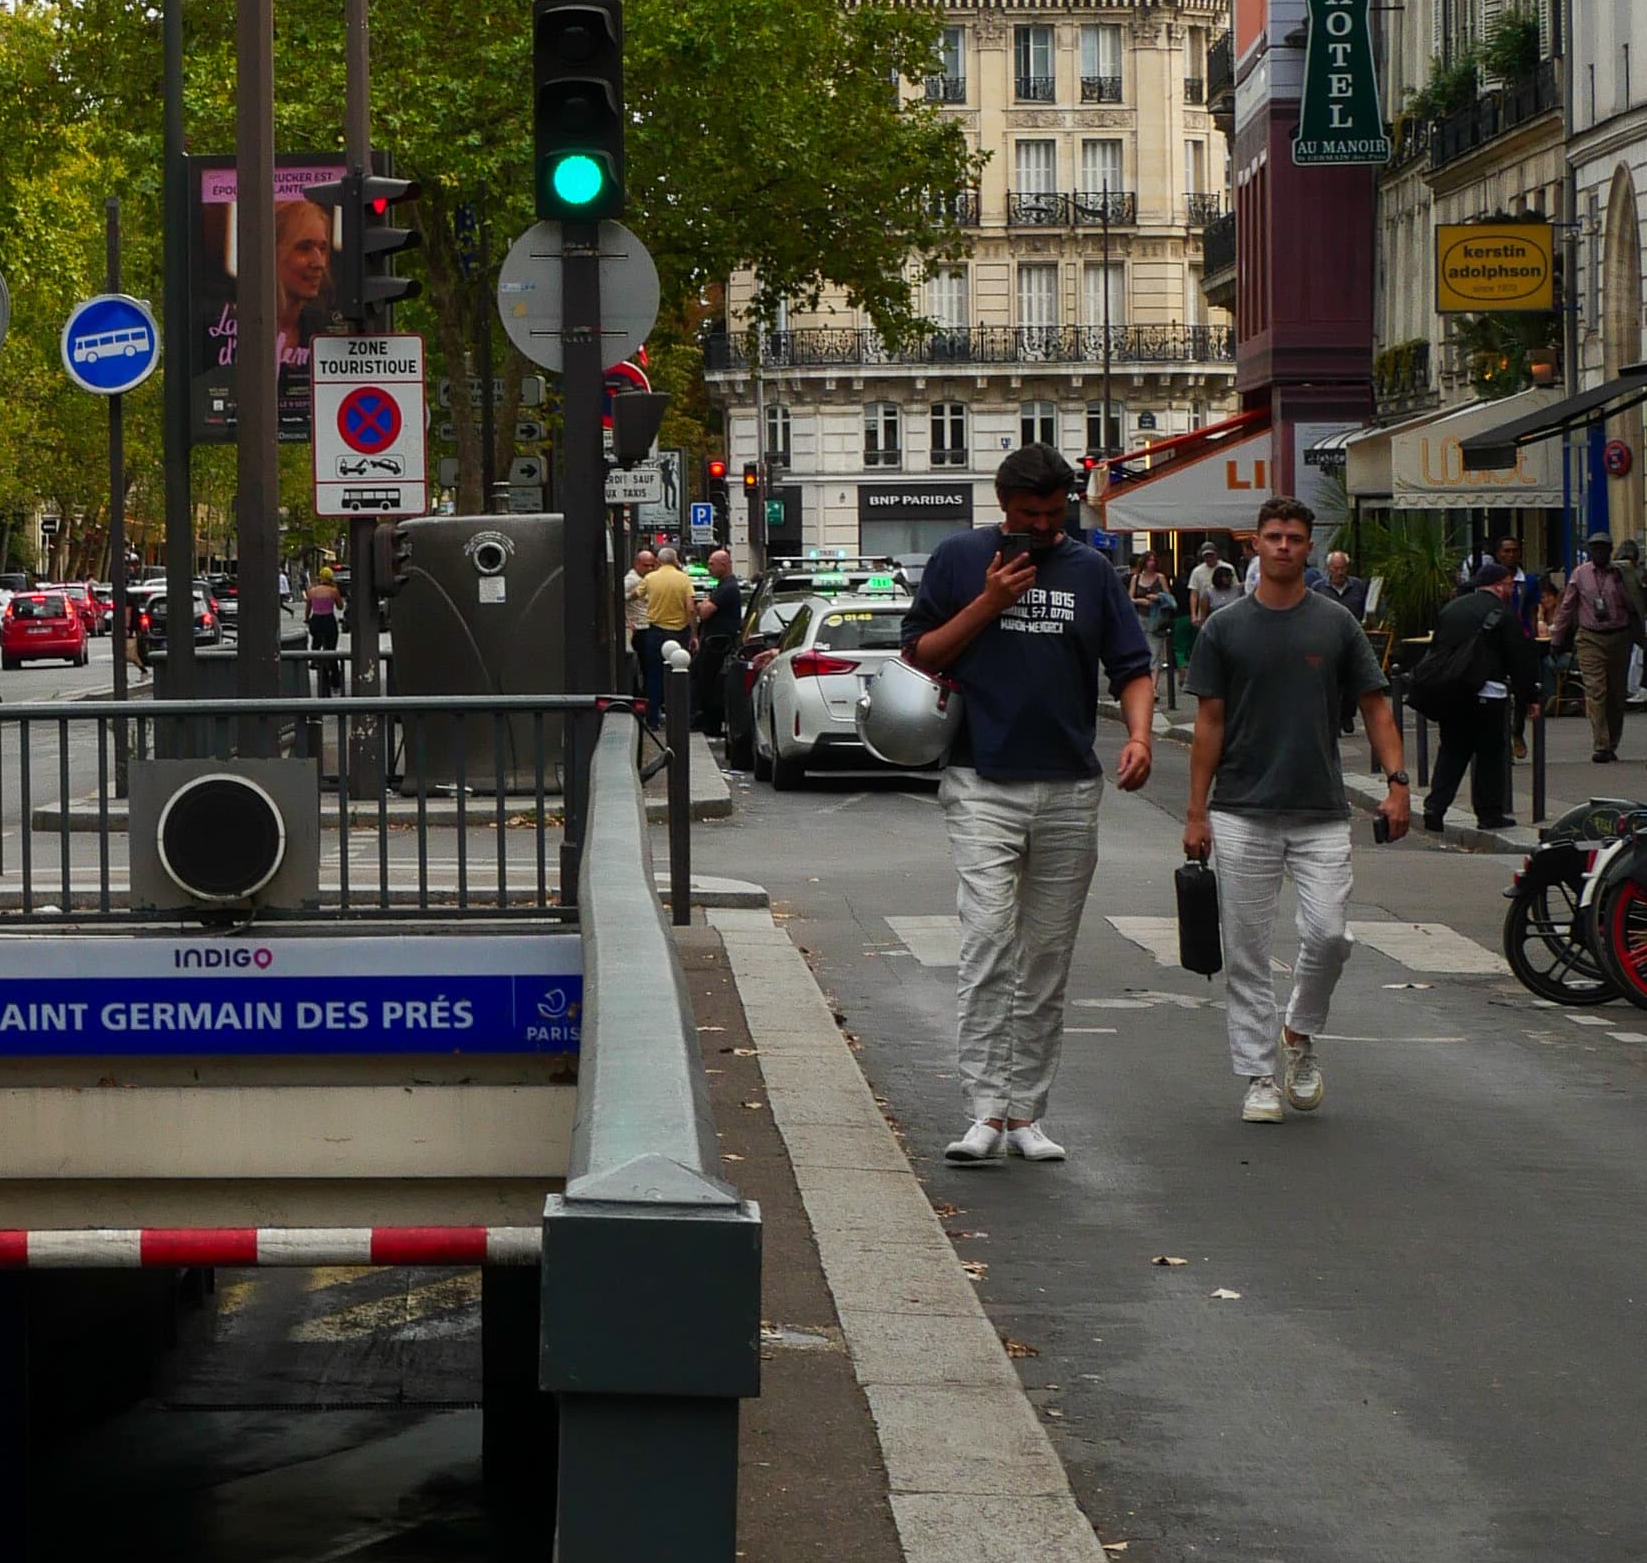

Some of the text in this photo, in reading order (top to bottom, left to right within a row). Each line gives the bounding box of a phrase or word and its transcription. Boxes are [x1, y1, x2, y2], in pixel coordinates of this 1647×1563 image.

[1297, 140, 1386, 154] AU MANOIR
[274, 172, 333, 183] RUCKER EST
[1464, 245, 1526, 258] kerstin
[1449, 264, 1541, 281] adolphson
[348, 341, 388, 356] ZONE
[319, 360, 418, 375] TOURISTIQUE
[633, 474, 656, 484] SAUF
[1226, 460, 1273, 489] LI
[623, 488, 647, 498] TAXIS
[869, 494, 963, 505] BNP PARIBAS
[697, 508, 707, 523] P
[1050, 591, 1075, 608] 1815
[175, 947, 273, 970] INDIGO
[100, 1001, 283, 1031] GERMAIN
[297, 1001, 370, 1030] DES
[382, 994, 474, 1029] PRÉS
